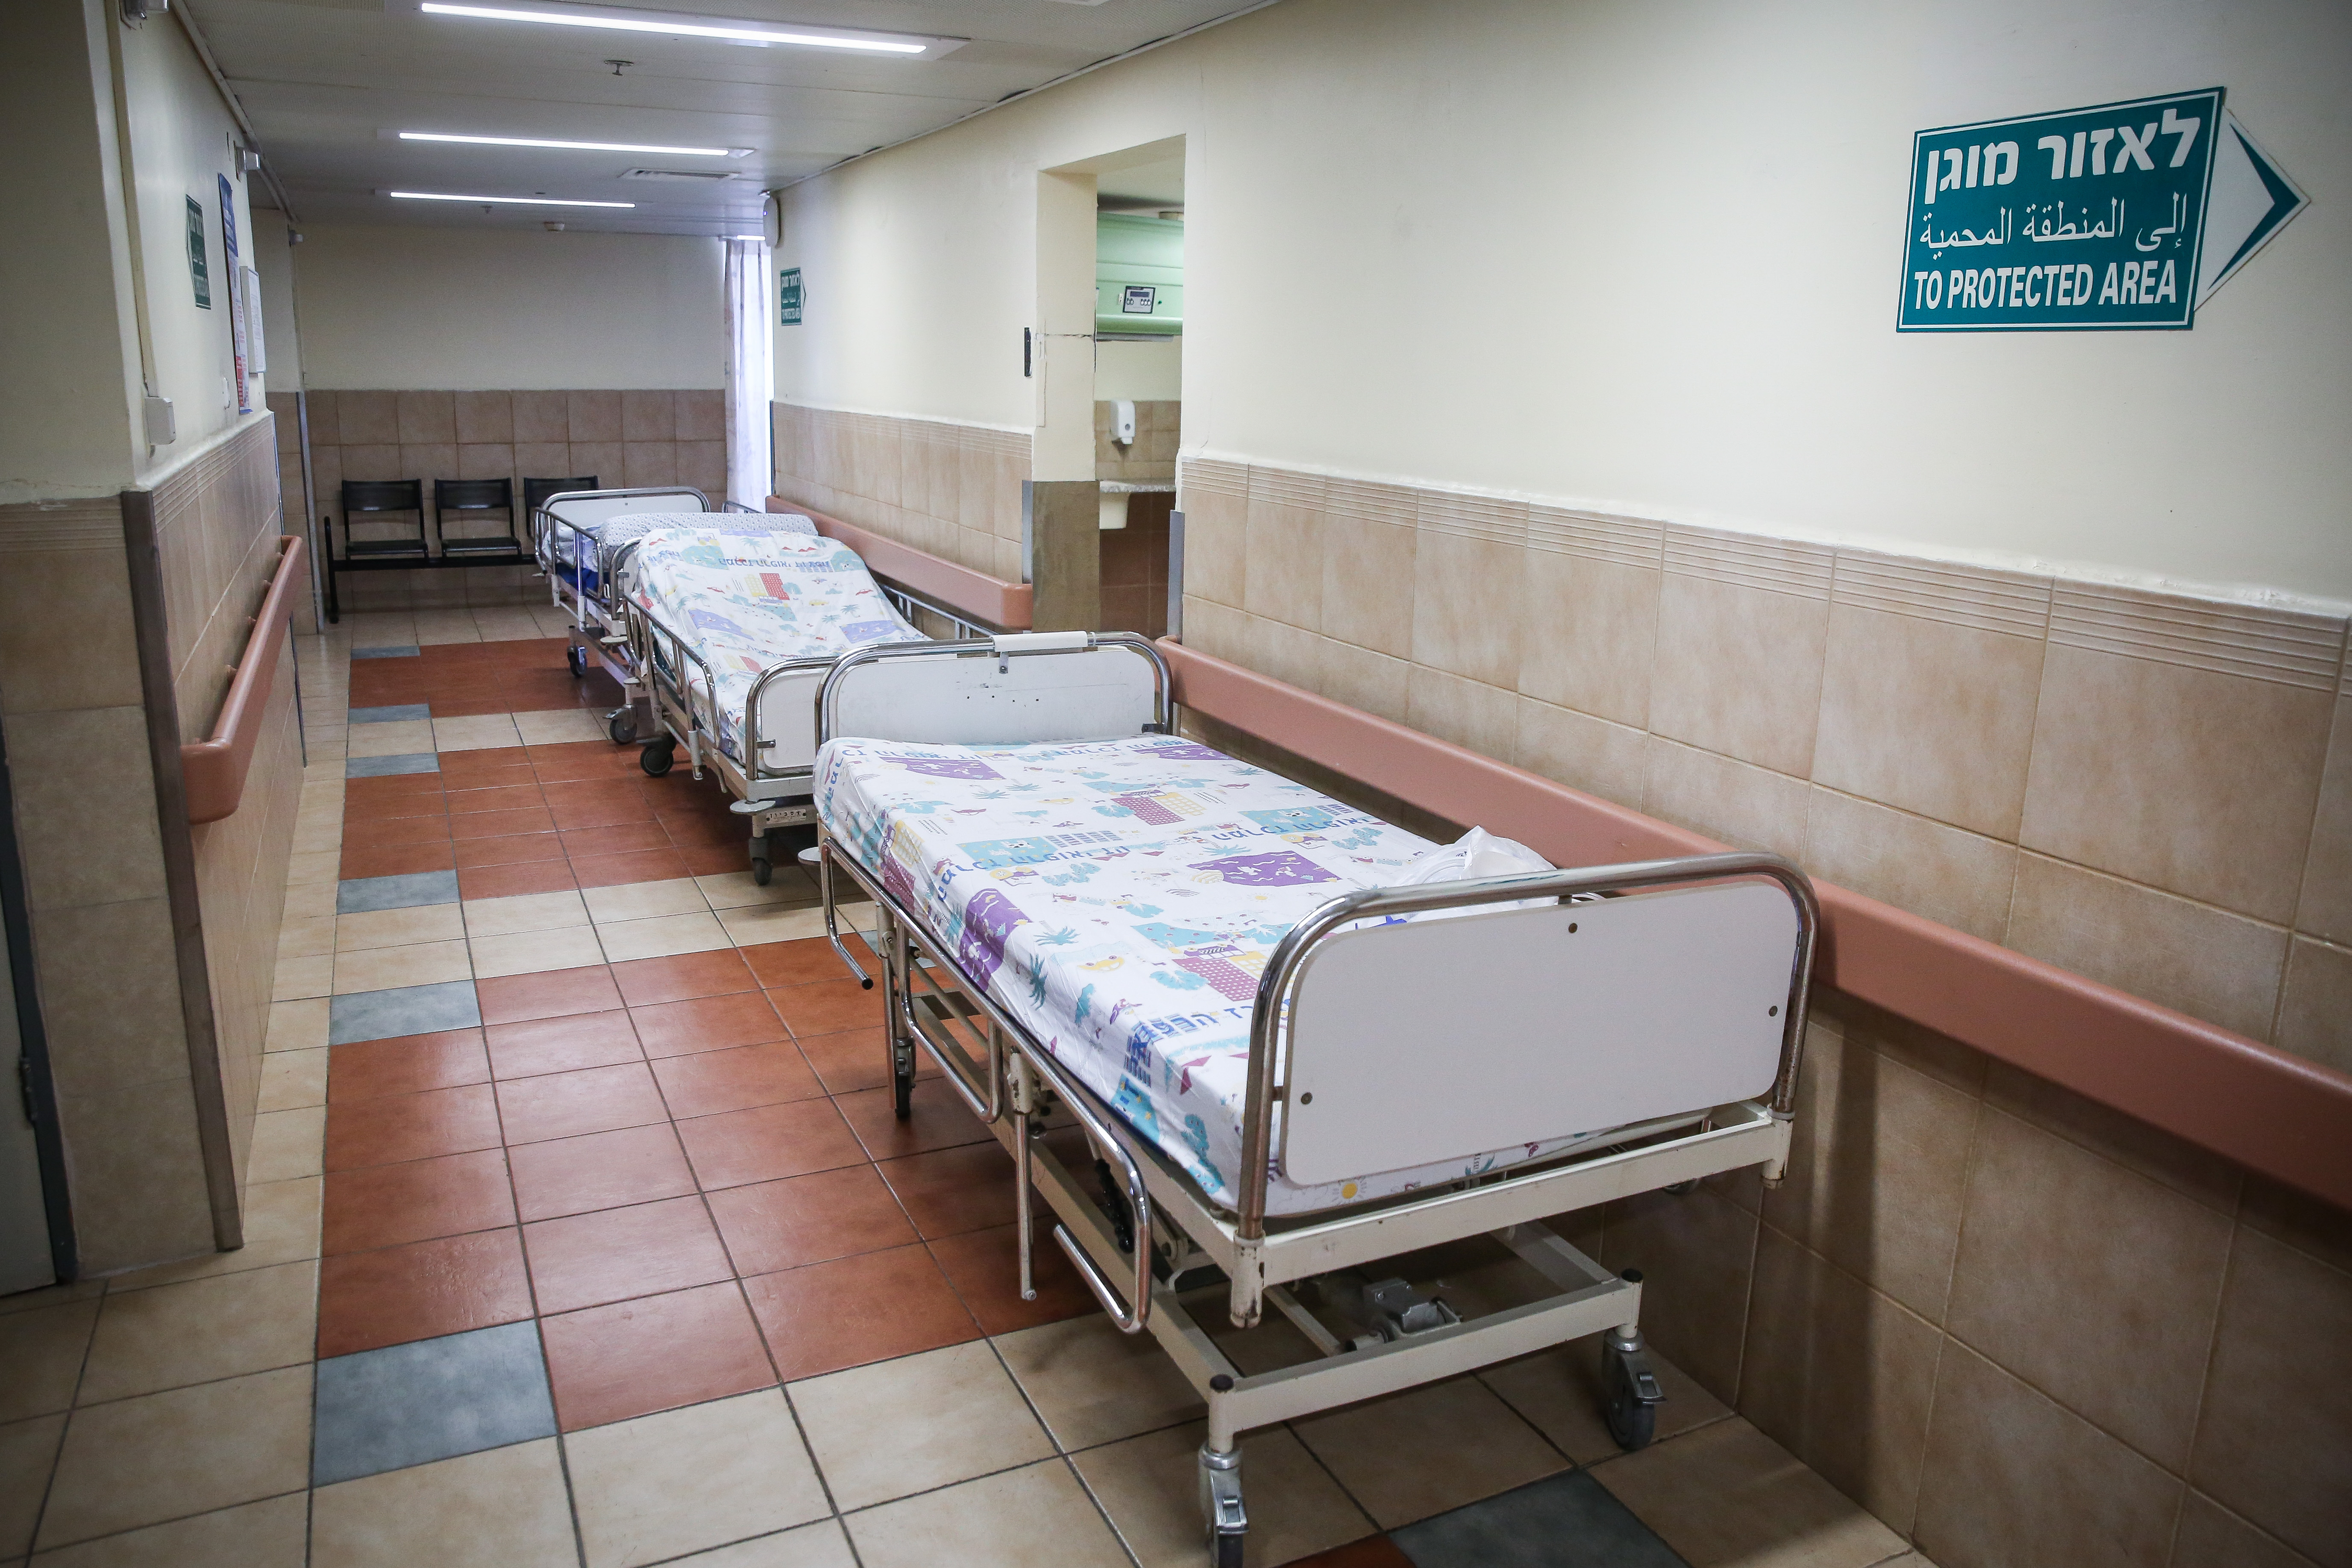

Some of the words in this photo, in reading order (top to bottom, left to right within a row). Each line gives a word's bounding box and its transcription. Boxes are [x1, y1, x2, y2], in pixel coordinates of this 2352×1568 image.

[2038, 108, 2200, 180] לאזור
[1924, 141, 2020, 204] מוגן
[1919, 206, 2013, 260] المحمية
[2022, 196, 2125, 242] المنطقة
[2135, 191, 2187, 251] إلى
[1914, 270, 1943, 310] TO
[1947, 263, 2093, 309] PROTECTED
[2099, 259, 2176, 306] AREA
[1211, 825, 1289, 841] המרכז
[1292, 817, 1370, 831] הרפואי
[1009, 849, 1093, 864] הרפואי
